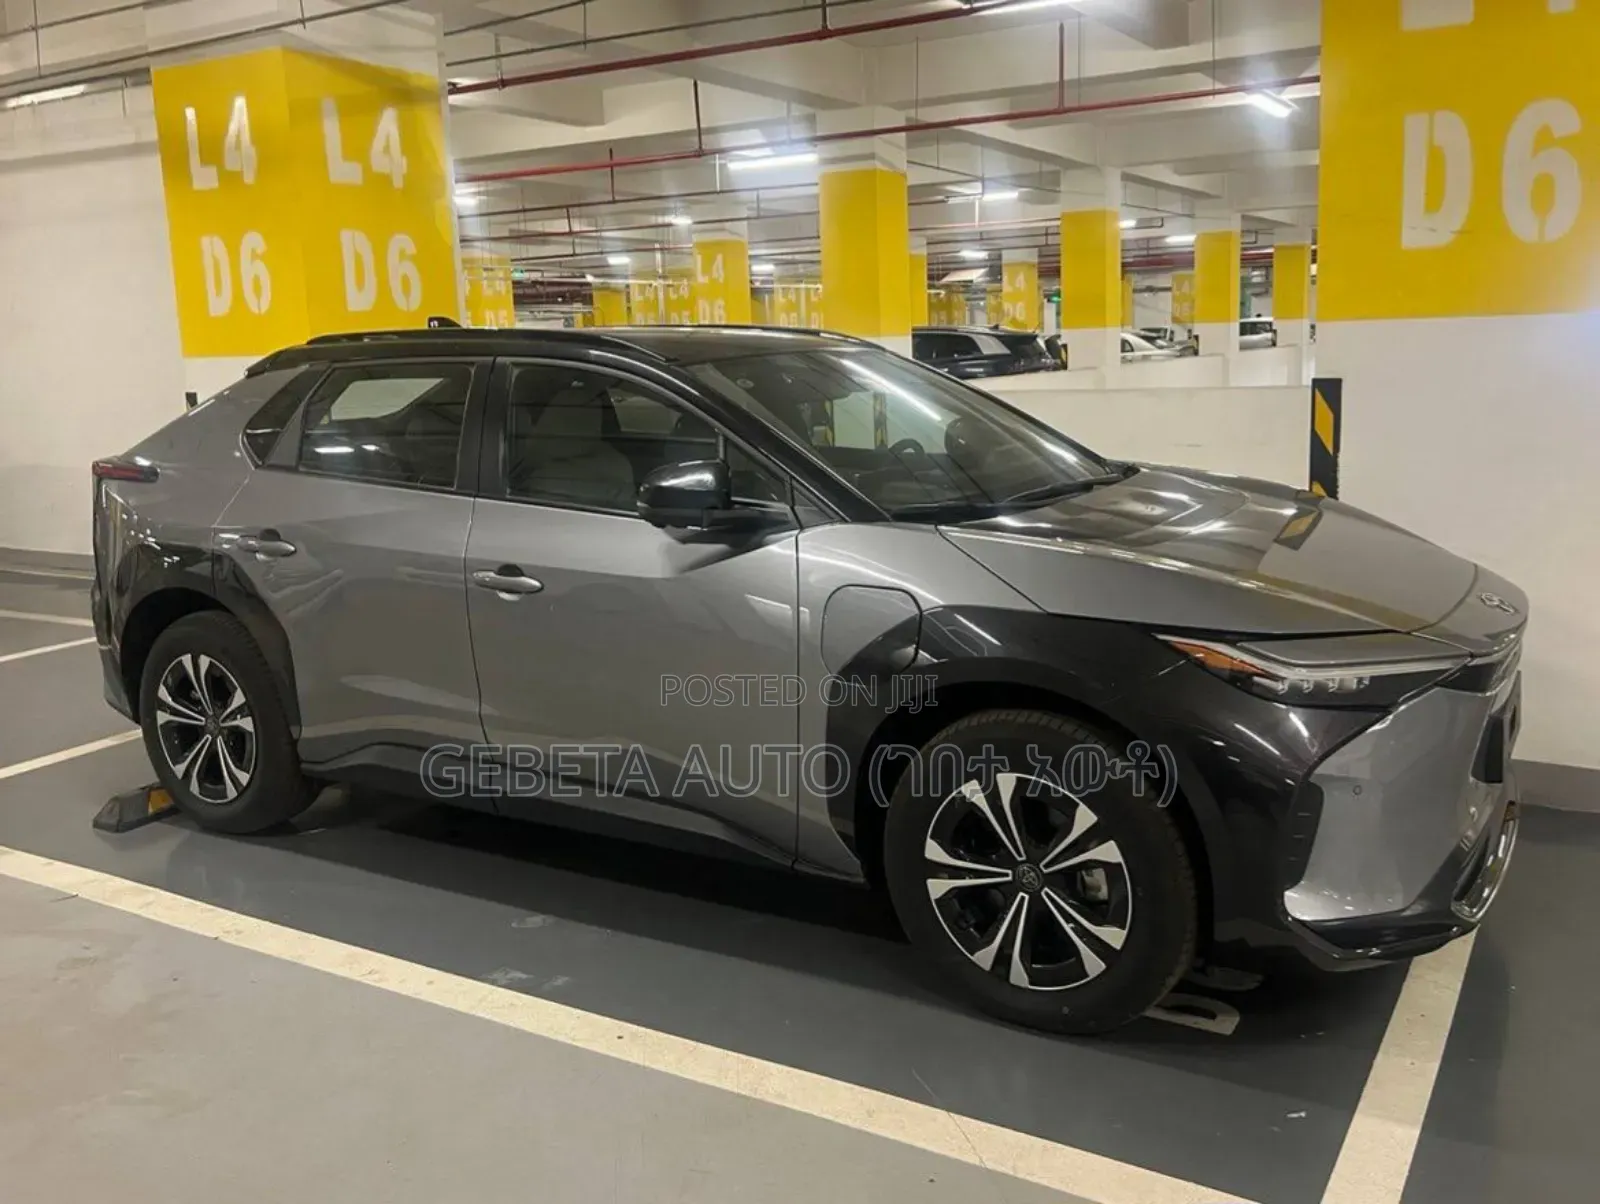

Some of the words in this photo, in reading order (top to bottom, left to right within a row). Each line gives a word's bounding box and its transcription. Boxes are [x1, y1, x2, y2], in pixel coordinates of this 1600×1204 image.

[186, 96, 257, 190] L4
[321, 97, 406, 189] L4
[1400, 98, 1582, 250] D6
[201, 231, 271, 317] D6
[339, 228, 421, 312] D6
[697, 253, 725, 284] L4
[1003, 271, 1025, 293] L4
[698, 297, 726, 326] D6
